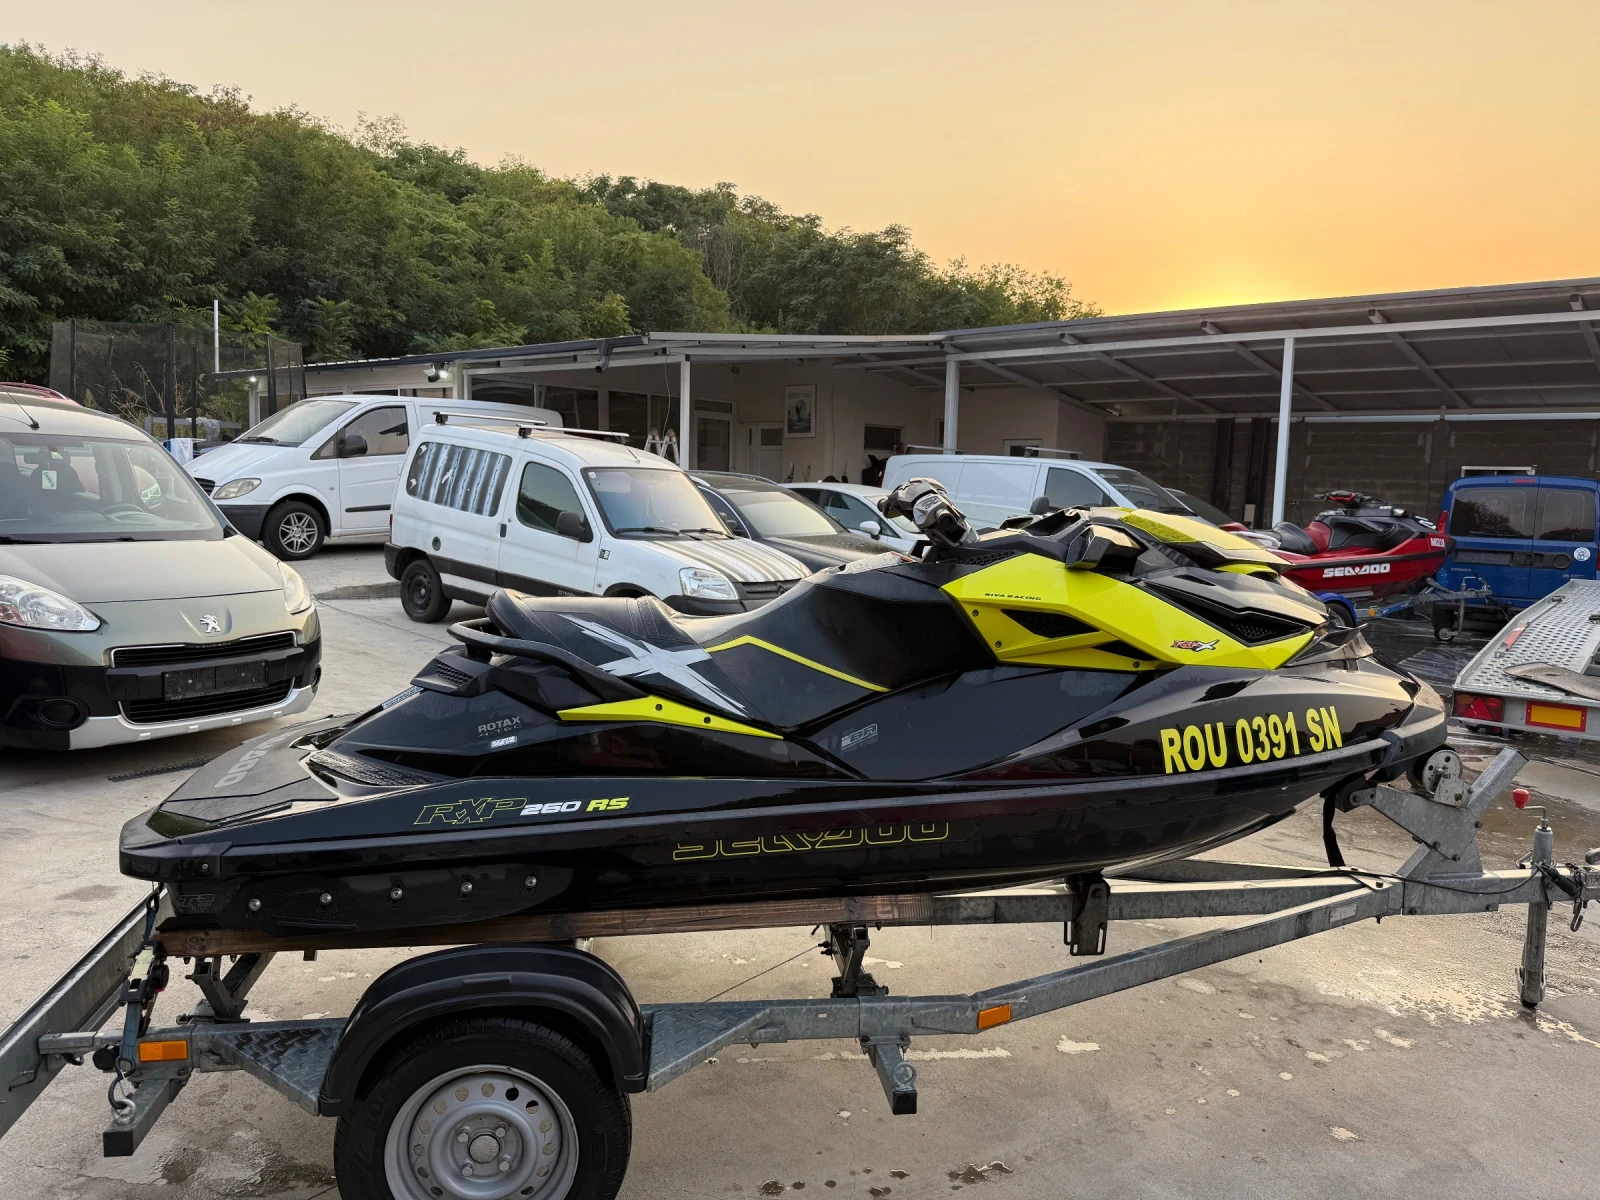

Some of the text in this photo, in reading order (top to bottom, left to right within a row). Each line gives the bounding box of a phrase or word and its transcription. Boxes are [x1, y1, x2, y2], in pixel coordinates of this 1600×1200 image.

[478, 716, 521, 733] ROTAX
[1160, 705, 1343, 775] ROU 0391 SN
[413, 796, 630, 825] RXP 260 RS
